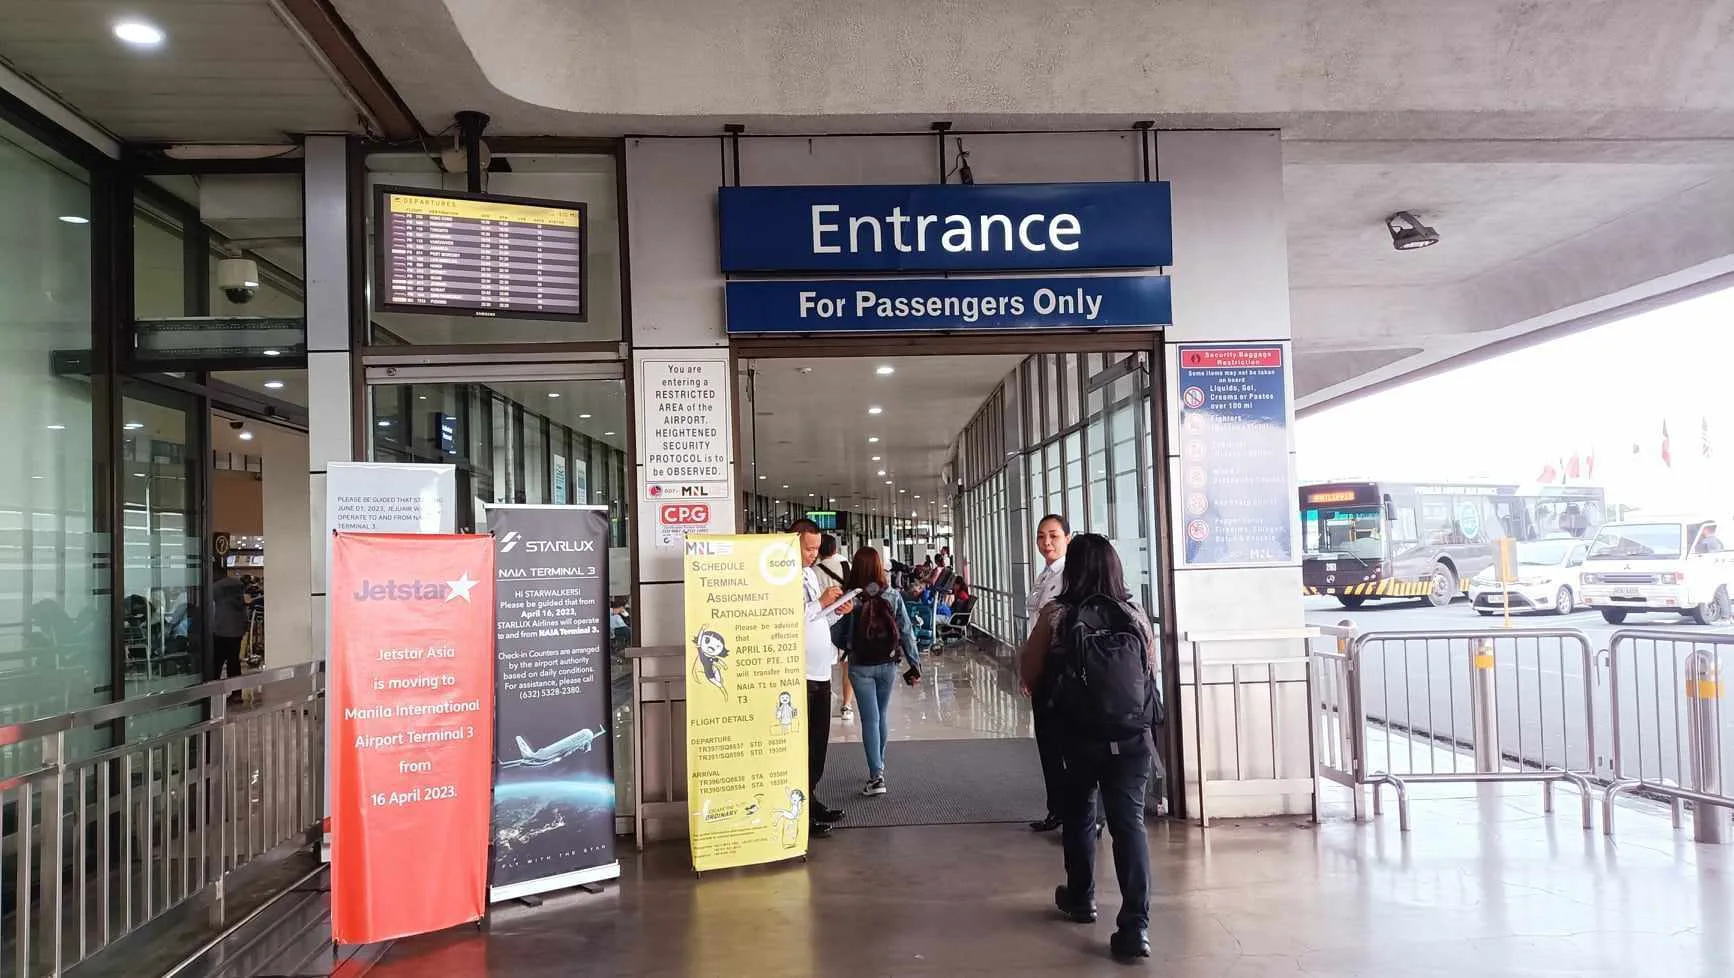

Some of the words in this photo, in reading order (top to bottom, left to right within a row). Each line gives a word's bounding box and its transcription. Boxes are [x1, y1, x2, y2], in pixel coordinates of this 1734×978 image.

[403, 197, 456, 207] DEPARTURES
[811, 204, 1081, 254] Entrance
[799, 291, 845, 318] For
[856, 290, 1024, 321] Passengers
[1033, 287, 1103, 320] Only
[1204, 351, 1236, 359] Security
[1238, 351, 1272, 359] Baggage
[668, 364, 684, 373] You
[662, 379, 700, 387] entering
[1210, 384, 1240, 392] Liquids,
[1242, 384, 1257, 392] Gel,
[659, 403, 683, 412] AREA
[664, 416, 708, 424] AIRPORT.
[656, 429, 716, 437] HEIGHTENED
[663, 442, 710, 450] SECURITY
[649, 455, 702, 463] PROTOCOL
[653, 468, 664, 476] be
[666, 467, 721, 476] OBSERVED.
[526, 540, 594, 552] STARLUX
[692, 561, 744, 572] SCHEDULE
[498, 568, 526, 578] NAIA
[530, 567, 584, 576] TERMINAL
[587, 566, 596, 574] 3
[700, 578, 748, 588] TERMINAL
[354, 580, 451, 600] Jetstar
[706, 593, 769, 602] ASSIGNMENT
[538, 599, 563, 608] guided
[521, 610, 540, 619] April
[712, 608, 794, 618] RATIONALIZATION
[498, 621, 530, 629] STARLUX
[506, 630, 520, 638] and
[560, 626, 590, 635] Terminal
[376, 647, 424, 660] Jetstar
[427, 646, 454, 658] Asia
[736, 646, 760, 654] APRIL
[764, 644, 776, 653] 16,
[778, 643, 796, 651] 2023
[498, 652, 528, 660] Check-in
[528, 650, 558, 658] Counters
[508, 662, 518, 670] by
[560, 656, 590, 666] authority
[736, 658, 761, 666] SCOOT
[504, 672, 526, 680] based
[540, 669, 557, 677] daily
[753, 668, 780, 676] transfer
[374, 679, 384, 690] is
[388, 676, 439, 690] moving
[442, 674, 455, 686] to
[518, 680, 558, 688] assistance,
[560, 678, 581, 686] please
[780, 678, 800, 687] NAIA
[520, 690, 540, 700] (632)
[345, 706, 392, 720] Manila
[396, 700, 480, 716] International
[690, 718, 720, 726] FLIGHT
[722, 714, 754, 724] DETAILS
[356, 734, 404, 748] Airport
[407, 729, 464, 743] Terminal
[466, 727, 474, 738] 3
[690, 736, 732, 744] DEPARTURE
[400, 761, 431, 772] from
[372, 794, 386, 806] 16
[388, 789, 420, 806] April
